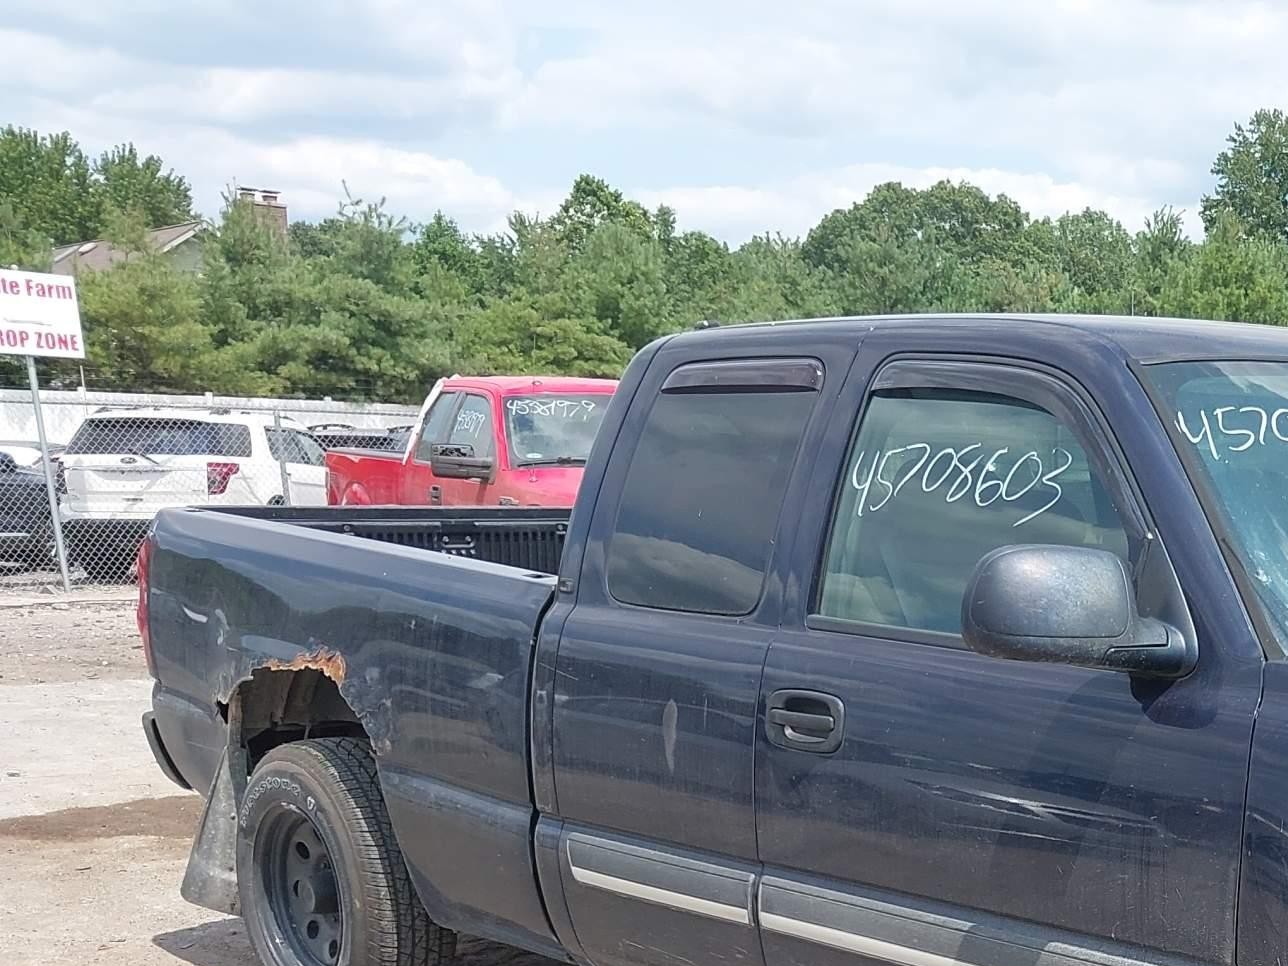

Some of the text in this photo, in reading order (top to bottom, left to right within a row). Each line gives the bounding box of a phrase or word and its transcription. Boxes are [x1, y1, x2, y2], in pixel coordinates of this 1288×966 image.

[0, 278, 73, 300] te Farm
[34, 331, 79, 351] ZONE
[852, 443, 1072, 526] 45708603
